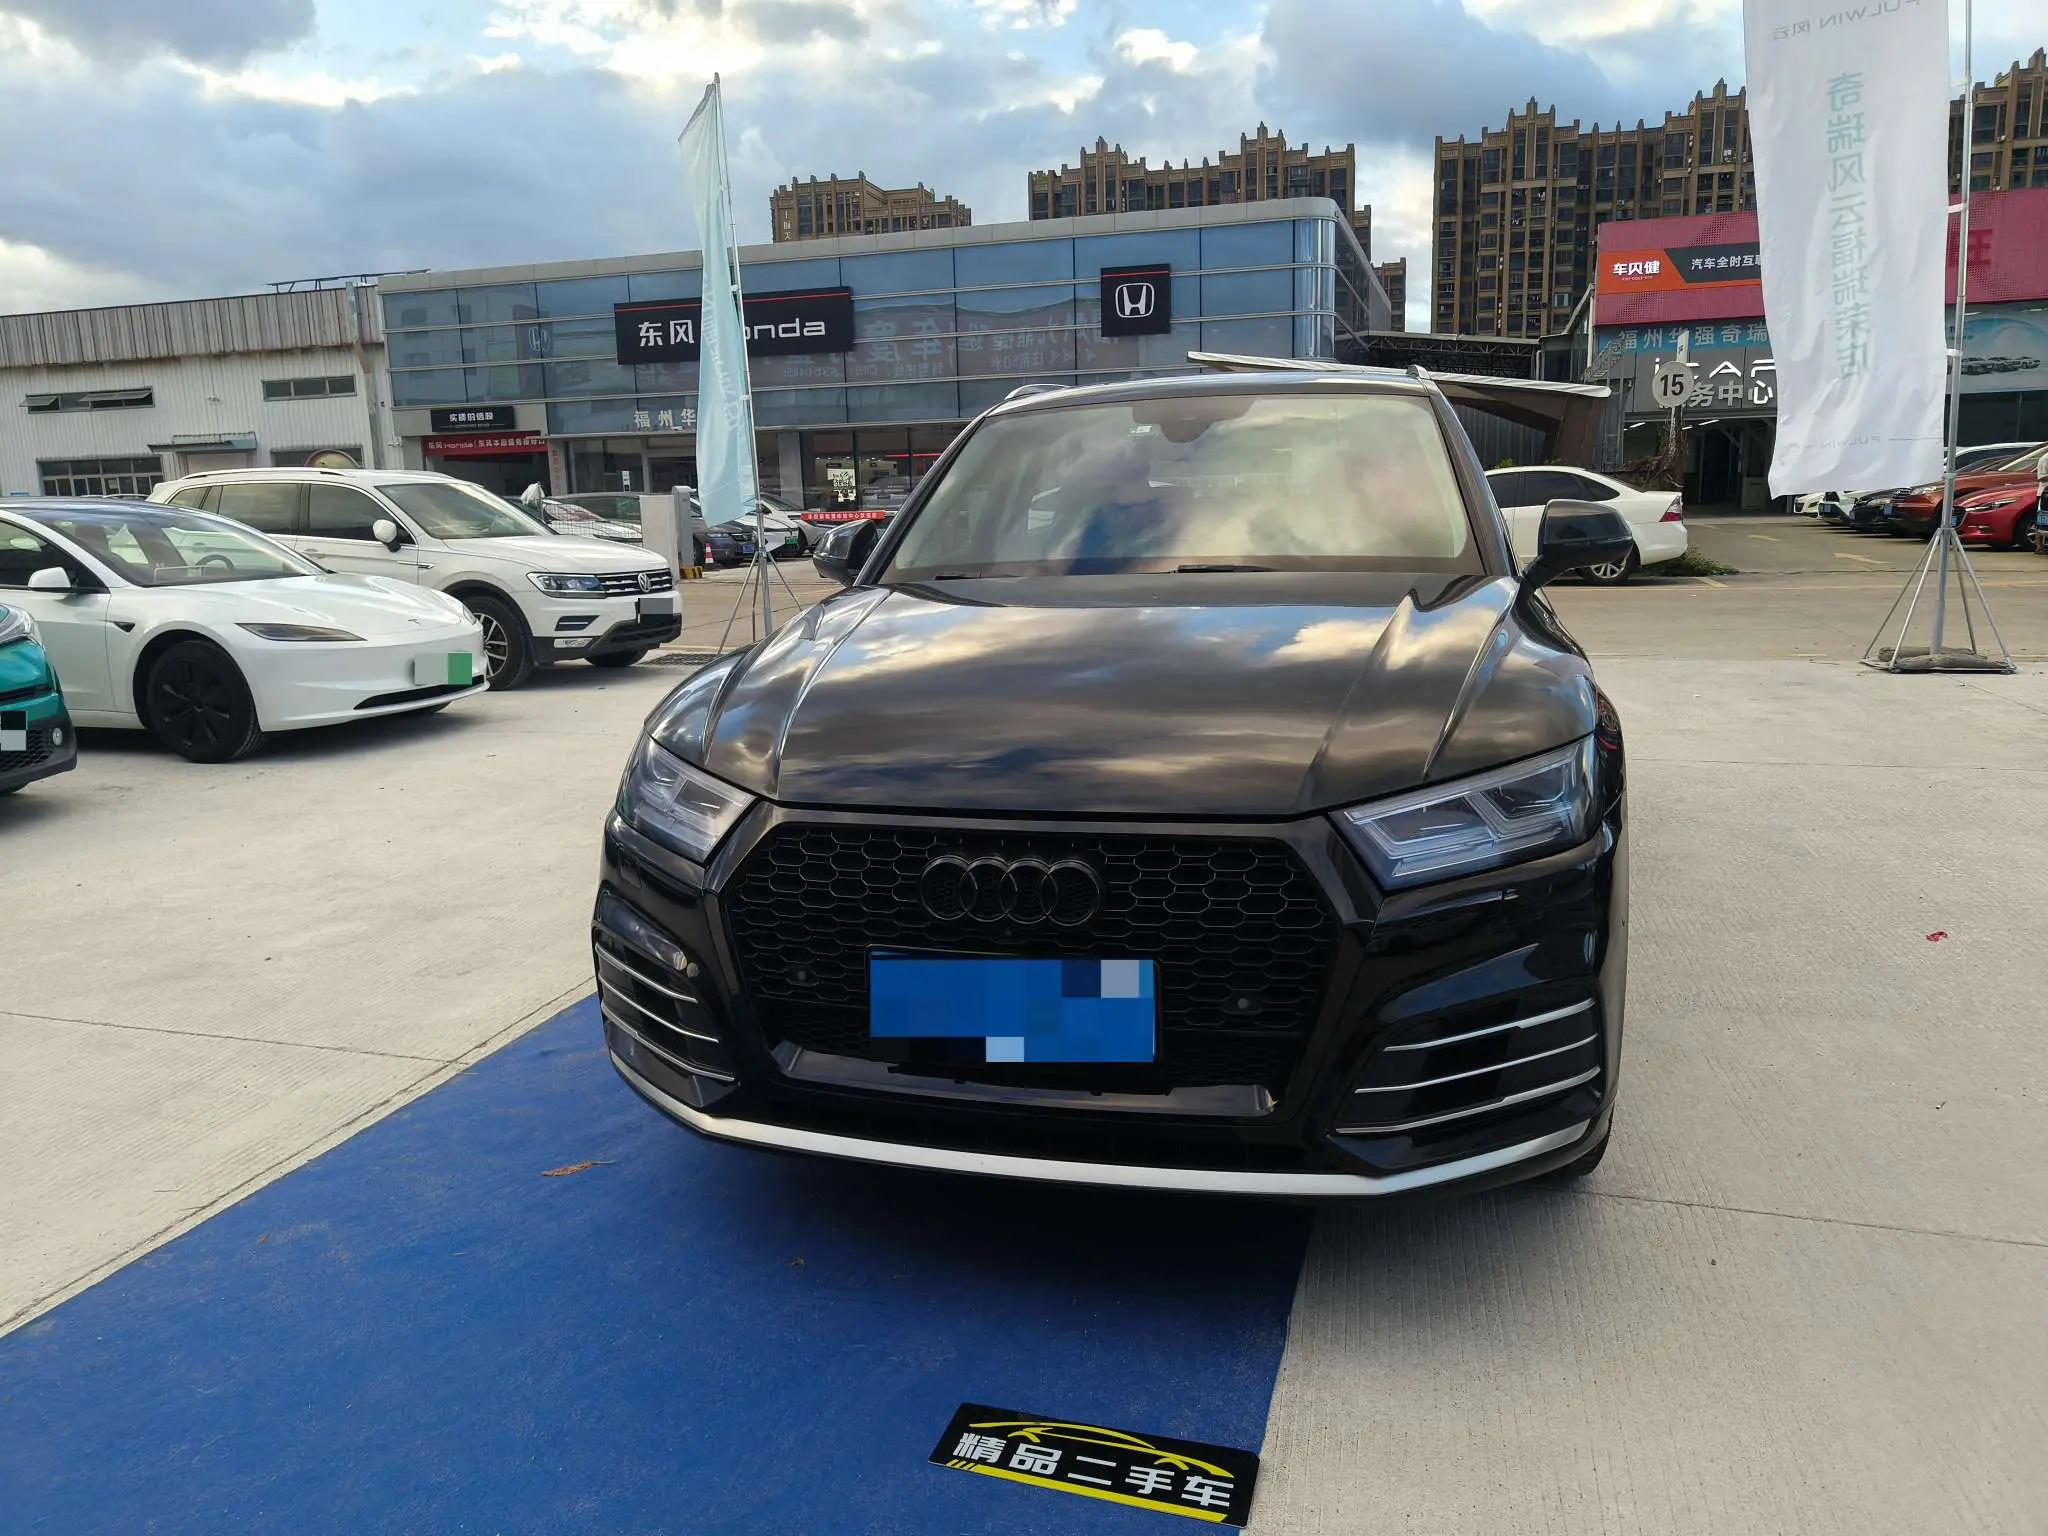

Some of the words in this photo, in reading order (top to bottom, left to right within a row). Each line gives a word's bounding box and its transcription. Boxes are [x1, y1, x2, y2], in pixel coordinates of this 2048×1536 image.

[638, 319, 695, 347] 东风
[1659, 379, 1774, 408] 务中心
[1660, 373, 1685, 397] 15
[634, 408, 697, 428] 福州华
[953, 1432, 1235, 1508] 精品二手车
